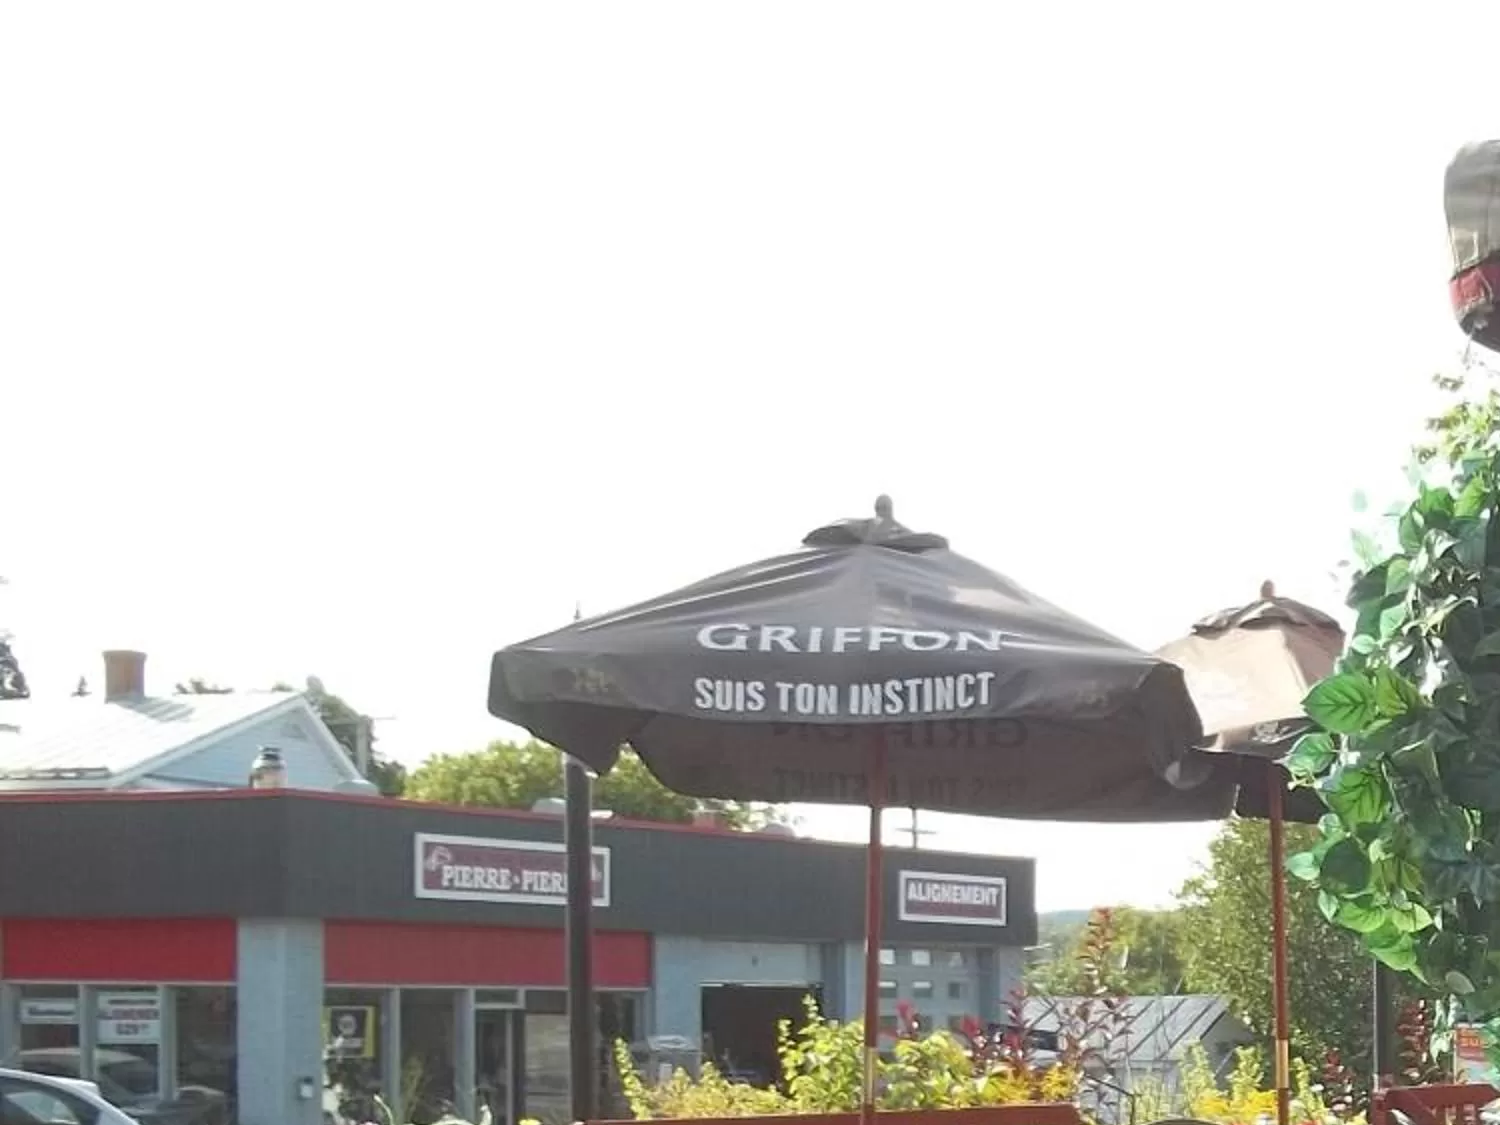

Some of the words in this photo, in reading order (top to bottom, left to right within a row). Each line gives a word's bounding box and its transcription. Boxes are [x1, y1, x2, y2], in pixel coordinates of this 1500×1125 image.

[696, 623, 1001, 652] GRIFFON
[695, 677, 765, 712] SUIS
[775, 682, 838, 714] TON
[849, 671, 994, 714] INSTINCT
[441, 865, 511, 890] PIERRE
[521, 869, 569, 893] PIER
[907, 882, 999, 906] ALIGNEMENT
